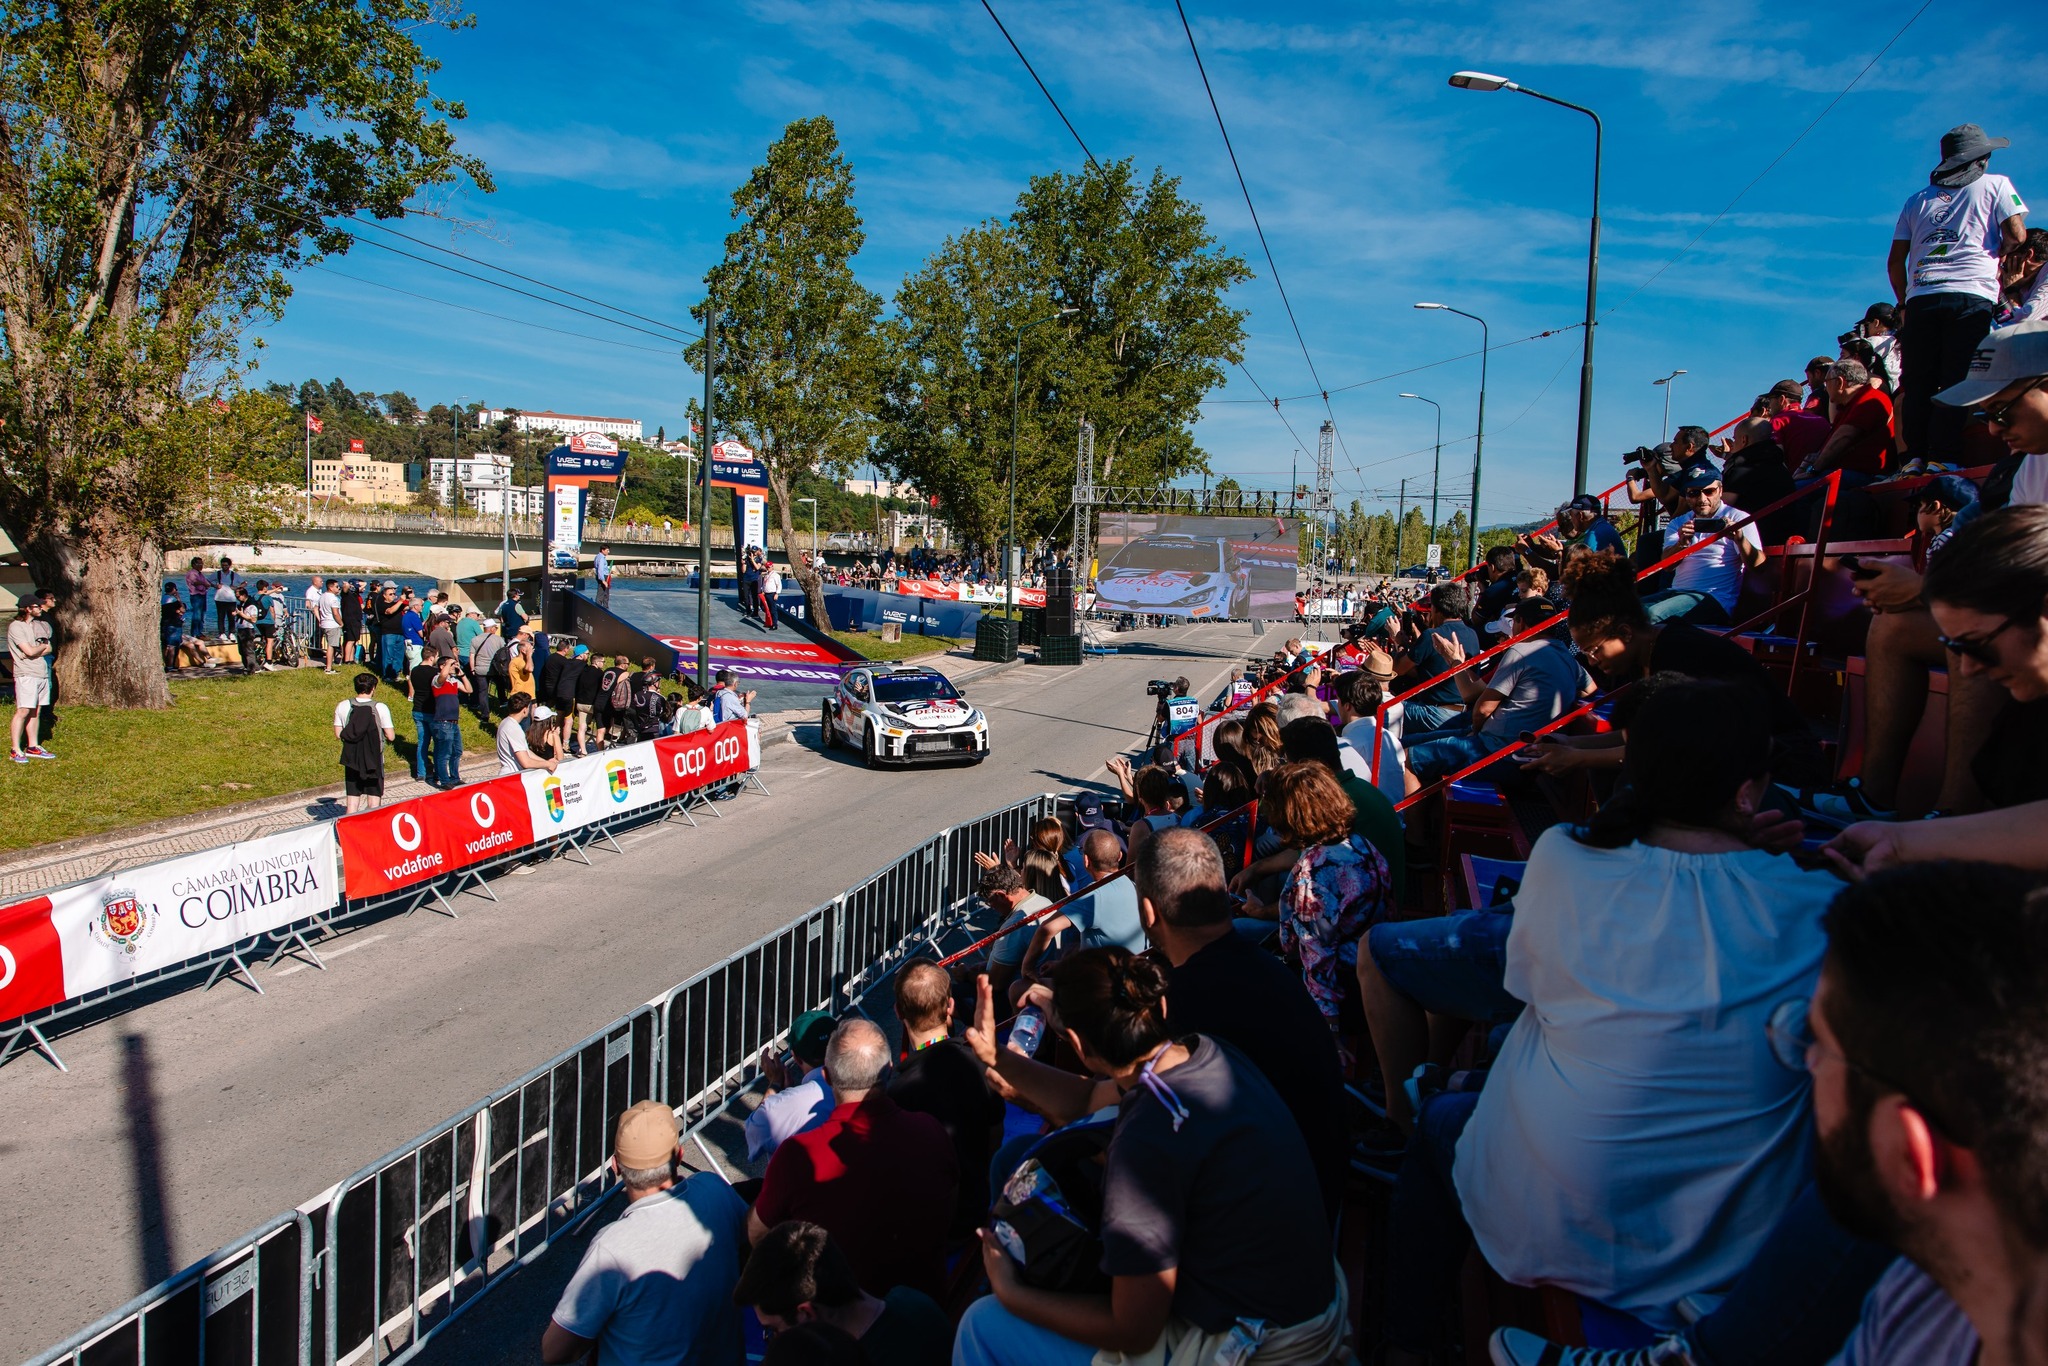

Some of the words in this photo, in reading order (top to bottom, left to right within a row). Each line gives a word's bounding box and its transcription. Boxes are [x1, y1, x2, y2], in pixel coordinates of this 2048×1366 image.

[556, 456, 581, 464] WRC
[741, 467, 761, 475] WRC
[1113, 577, 1175, 588] DENSO
[883, 609, 907, 619] WRC
[708, 644, 819, 657] vodafone
[679, 660, 841, 681] #COIMBR
[1176, 706, 1193, 716] 804
[714, 736, 740, 765] acp
[674, 747, 706, 777] acp
[628, 765, 644, 774] Turismo
[629, 772, 643, 780] Centro
[563, 781, 580, 791] Turismo
[630, 778, 648, 787] Portugal
[564, 790, 578, 798] Centro
[565, 795, 583, 805] Portugal
[465, 828, 513, 855] vodafone
[384, 851, 443, 881] vodafone
[172, 867, 238, 897] CÂMARA
[239, 847, 316, 879] MUNICIPAL
[245, 876, 254, 885] DE
[179, 865, 319, 928] COIMBRA
